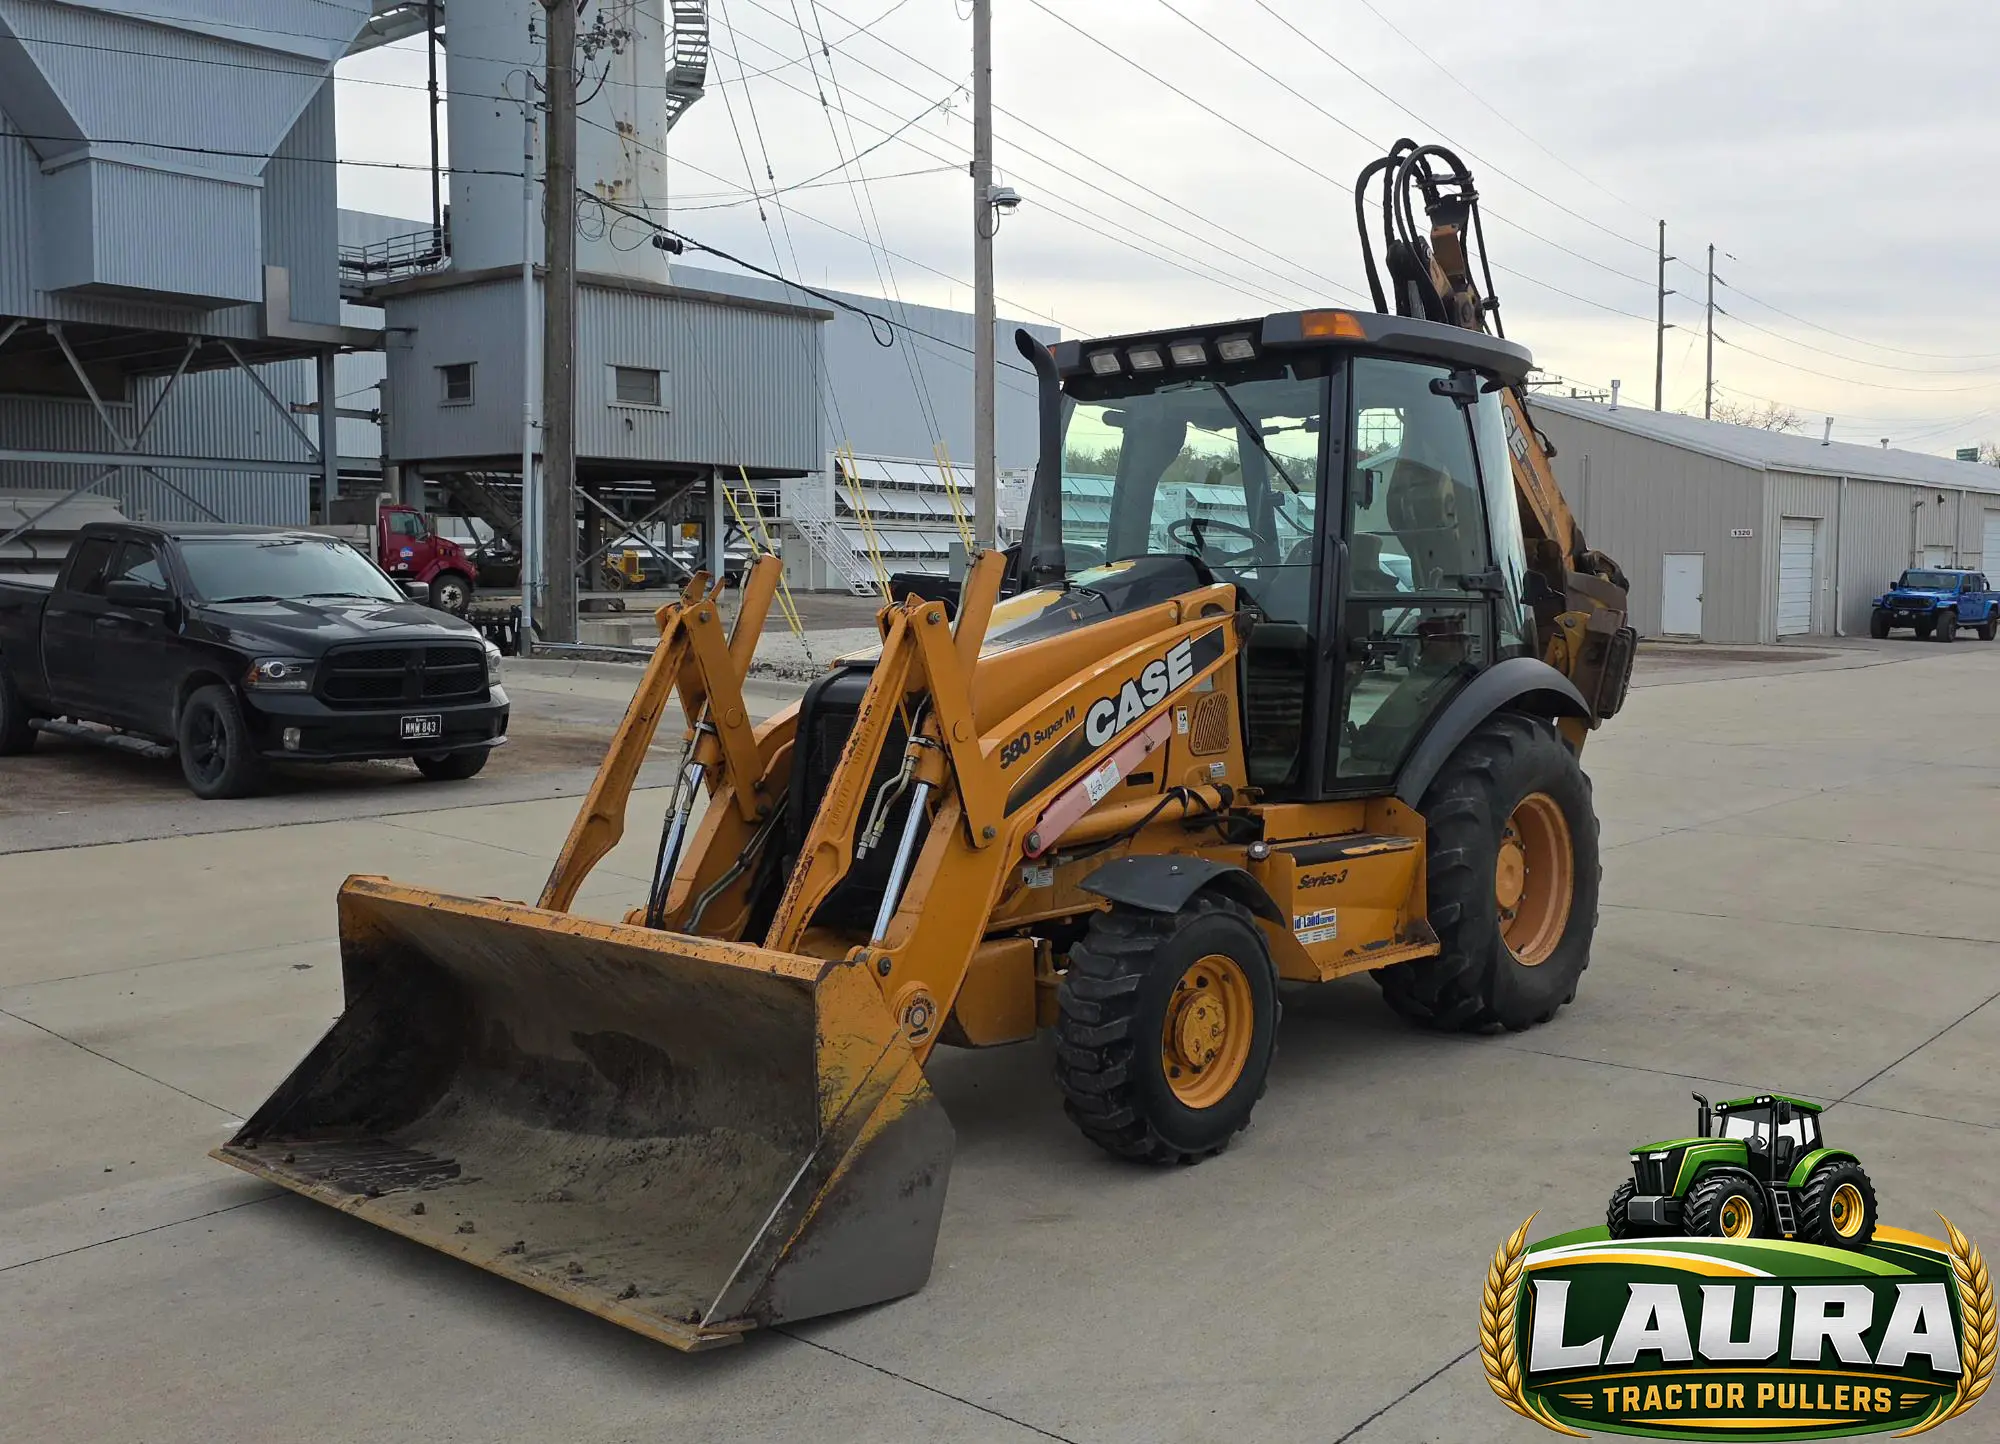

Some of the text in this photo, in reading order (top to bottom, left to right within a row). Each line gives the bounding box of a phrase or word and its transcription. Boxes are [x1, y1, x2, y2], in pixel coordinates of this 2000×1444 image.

[1498, 389, 1529, 461] SE
[1085, 636, 1194, 747] CASE
[422, 721, 436, 733] 843
[1000, 705, 1076, 769] 580 Super M
[1297, 869, 1348, 889] Series 3
